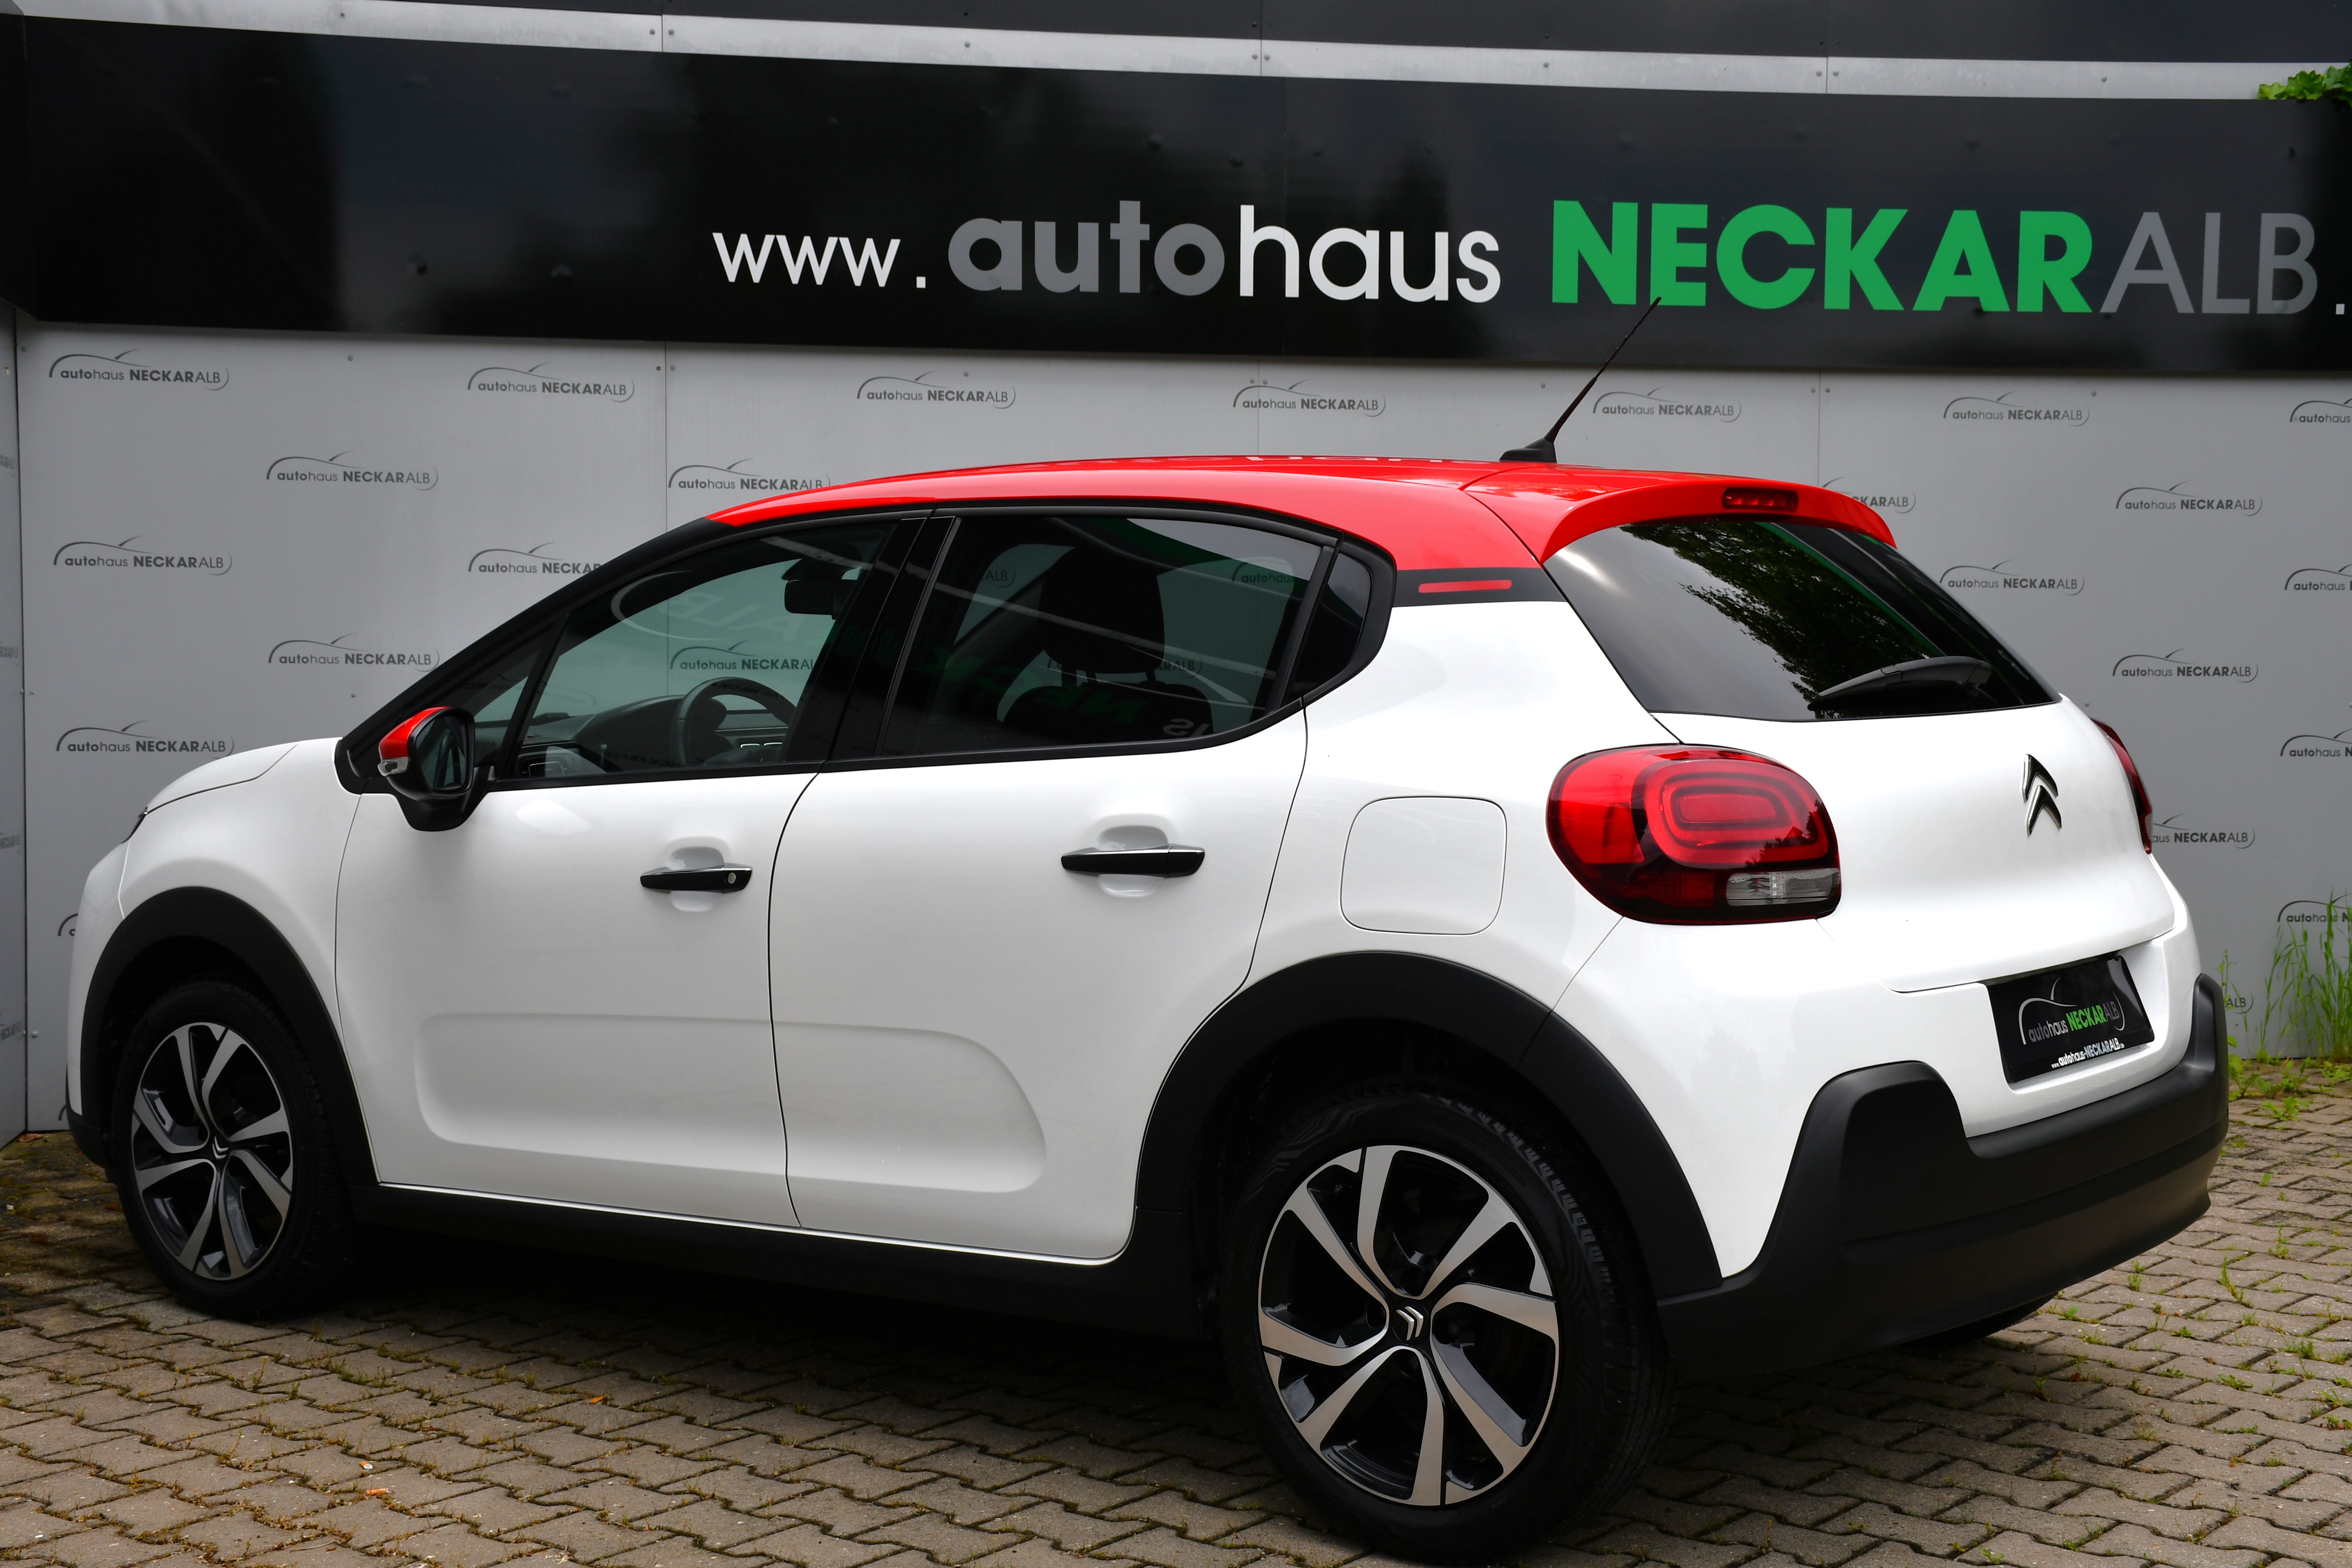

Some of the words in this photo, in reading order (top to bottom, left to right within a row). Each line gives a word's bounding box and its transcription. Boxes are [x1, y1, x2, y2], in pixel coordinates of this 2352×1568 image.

[947, 200, 1501, 303] autohaus
[60, 368, 124, 380] autohaus
[129, 369, 220, 384] NECKARALB
[478, 381, 537, 392] autohaus
[542, 381, 626, 395] NECKARALB
[866, 390, 923, 400] autohaus
[927, 389, 1008, 403] NECKARALB
[1242, 398, 1296, 409] autohaus
[1301, 398, 1378, 411] NECKARALB
[1602, 405, 1654, 415] autohaus
[1658, 404, 1734, 416] NECKARALB
[1952, 410, 2004, 420] autohaus
[2008, 409, 2082, 420] NECKARALB
[2298, 414, 2351, 423] autohaus
[277, 471, 338, 482] autohaus
[343, 471, 430, 484] NECKARALB
[678, 479, 736, 489] autohaus
[1851, 496, 1909, 507] KARALB
[2125, 500, 2176, 509] autohaus
[2180, 499, 2255, 510] NECKARALB
[65, 556, 128, 567] autohaus
[133, 555, 223, 569] NECKARALB
[478, 563, 537, 573] autohaus
[1948, 578, 1999, 588] autohaus
[2003, 578, 2077, 589] NECKARALB
[2293, 581, 2345, 591] autohaus
[279, 654, 340, 664] autohaus
[344, 653, 431, 665] NECKARALB
[680, 659, 737, 670] autohaus
[741, 659, 814, 670] NECKARAL
[2121, 667, 2172, 677] autohaus
[2177, 666, 2251, 677] NECKARALB
[67, 741, 131, 752] autohaus
[136, 740, 226, 752] NECKARALB
[2289, 748, 2341, 757] autohaus
[2174, 832, 2248, 843] NECKARALB
[2287, 913, 2338, 923] autohas
[2028, 1020, 2068, 1043] autohaus
[2066, 1002, 2119, 1032] NECKARALB
